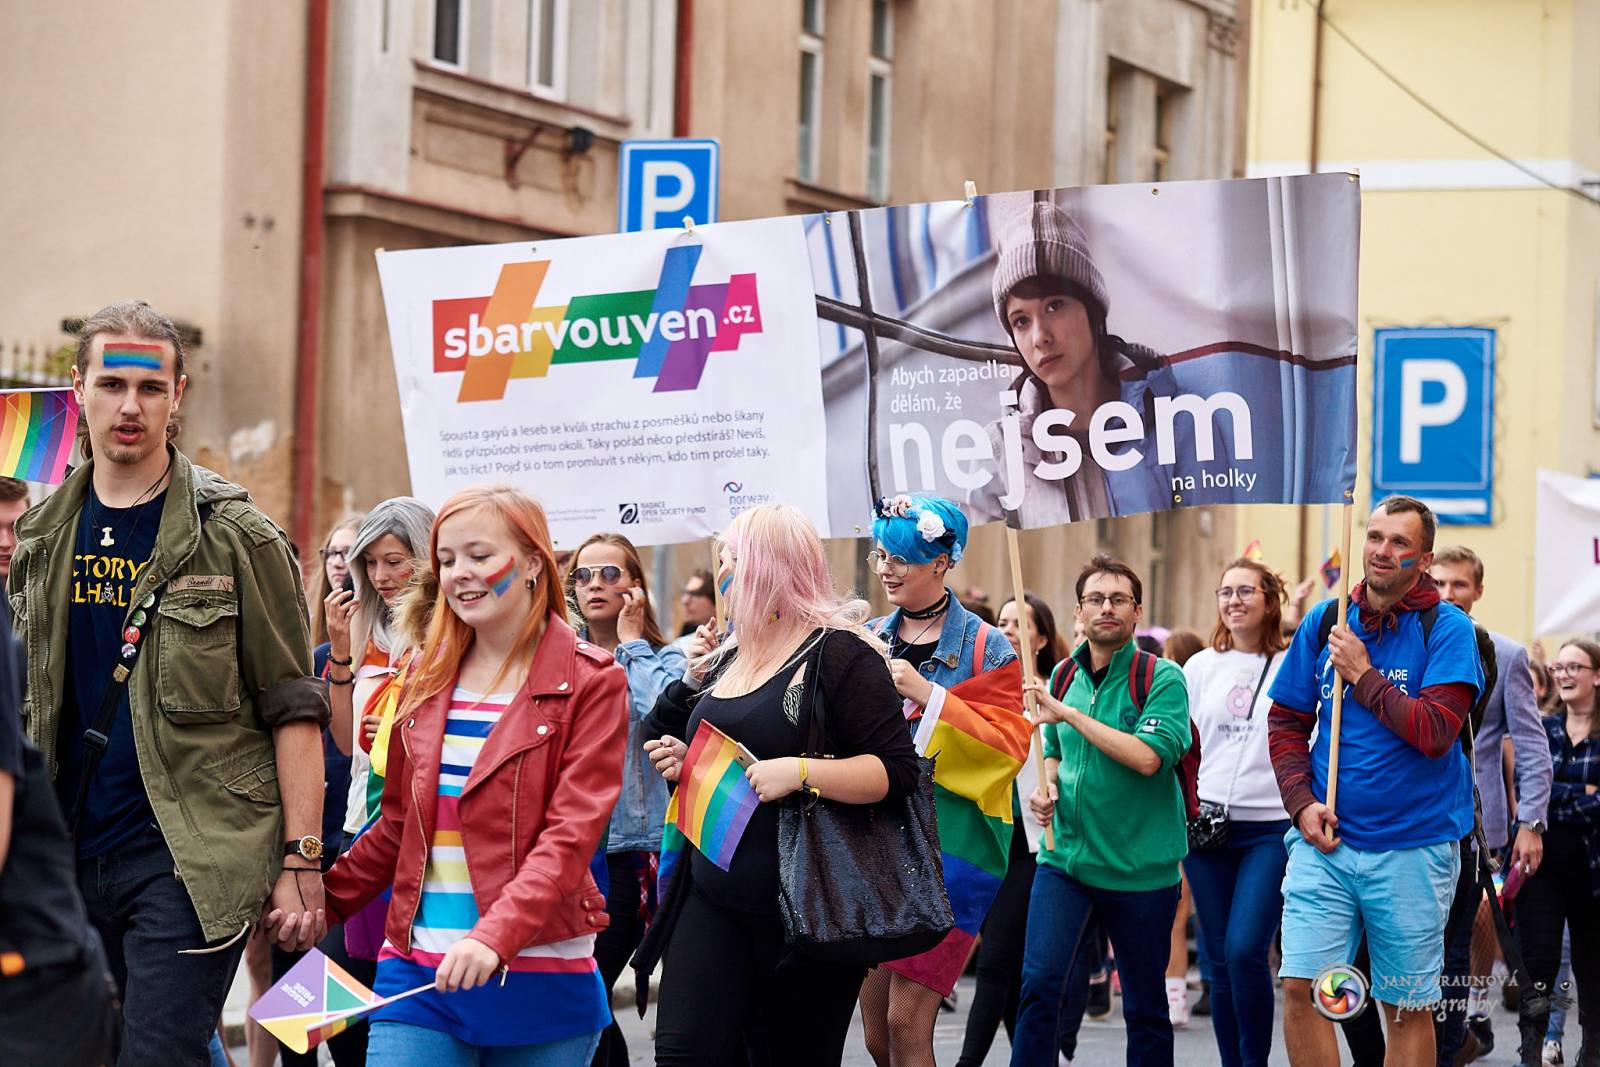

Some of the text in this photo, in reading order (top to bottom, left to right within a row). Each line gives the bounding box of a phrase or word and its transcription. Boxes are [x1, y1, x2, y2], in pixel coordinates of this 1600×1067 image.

[642, 160, 695, 232] P
[444, 304, 755, 359] sbarvouven.cz
[891, 365, 934, 390] Abych
[891, 391, 962, 414] dělám, že
[1400, 358, 1468, 464] P
[440, 410, 765, 442] Spousta gayů a leseb se kvůli strachu z posměšků nebo šikany
[523, 442, 557, 455] svému
[587, 437, 610, 452] Taky
[613, 434, 645, 450] pořád
[647, 433, 673, 446] něco
[676, 428, 735, 446] předstíráš?
[889, 391, 1253, 511] nejsem
[496, 460, 520, 475] Pojď
[523, 461, 532, 471] si
[534, 462, 542, 471] o
[543, 459, 564, 470] tom
[566, 455, 617, 470] promluvit
[620, 457, 626, 465] s
[668, 450, 688, 462] kdo
[690, 449, 710, 461] tím
[712, 446, 744, 462] prošel
[747, 445, 771, 460] taky.
[1172, 469, 1257, 492] na holky
[660, 507, 685, 515] SOCIETY
[687, 506, 706, 514] FUND
[729, 494, 769, 505] norway
[73, 554, 150, 581] CTORY
[1388, 669, 1408, 681] ARE
